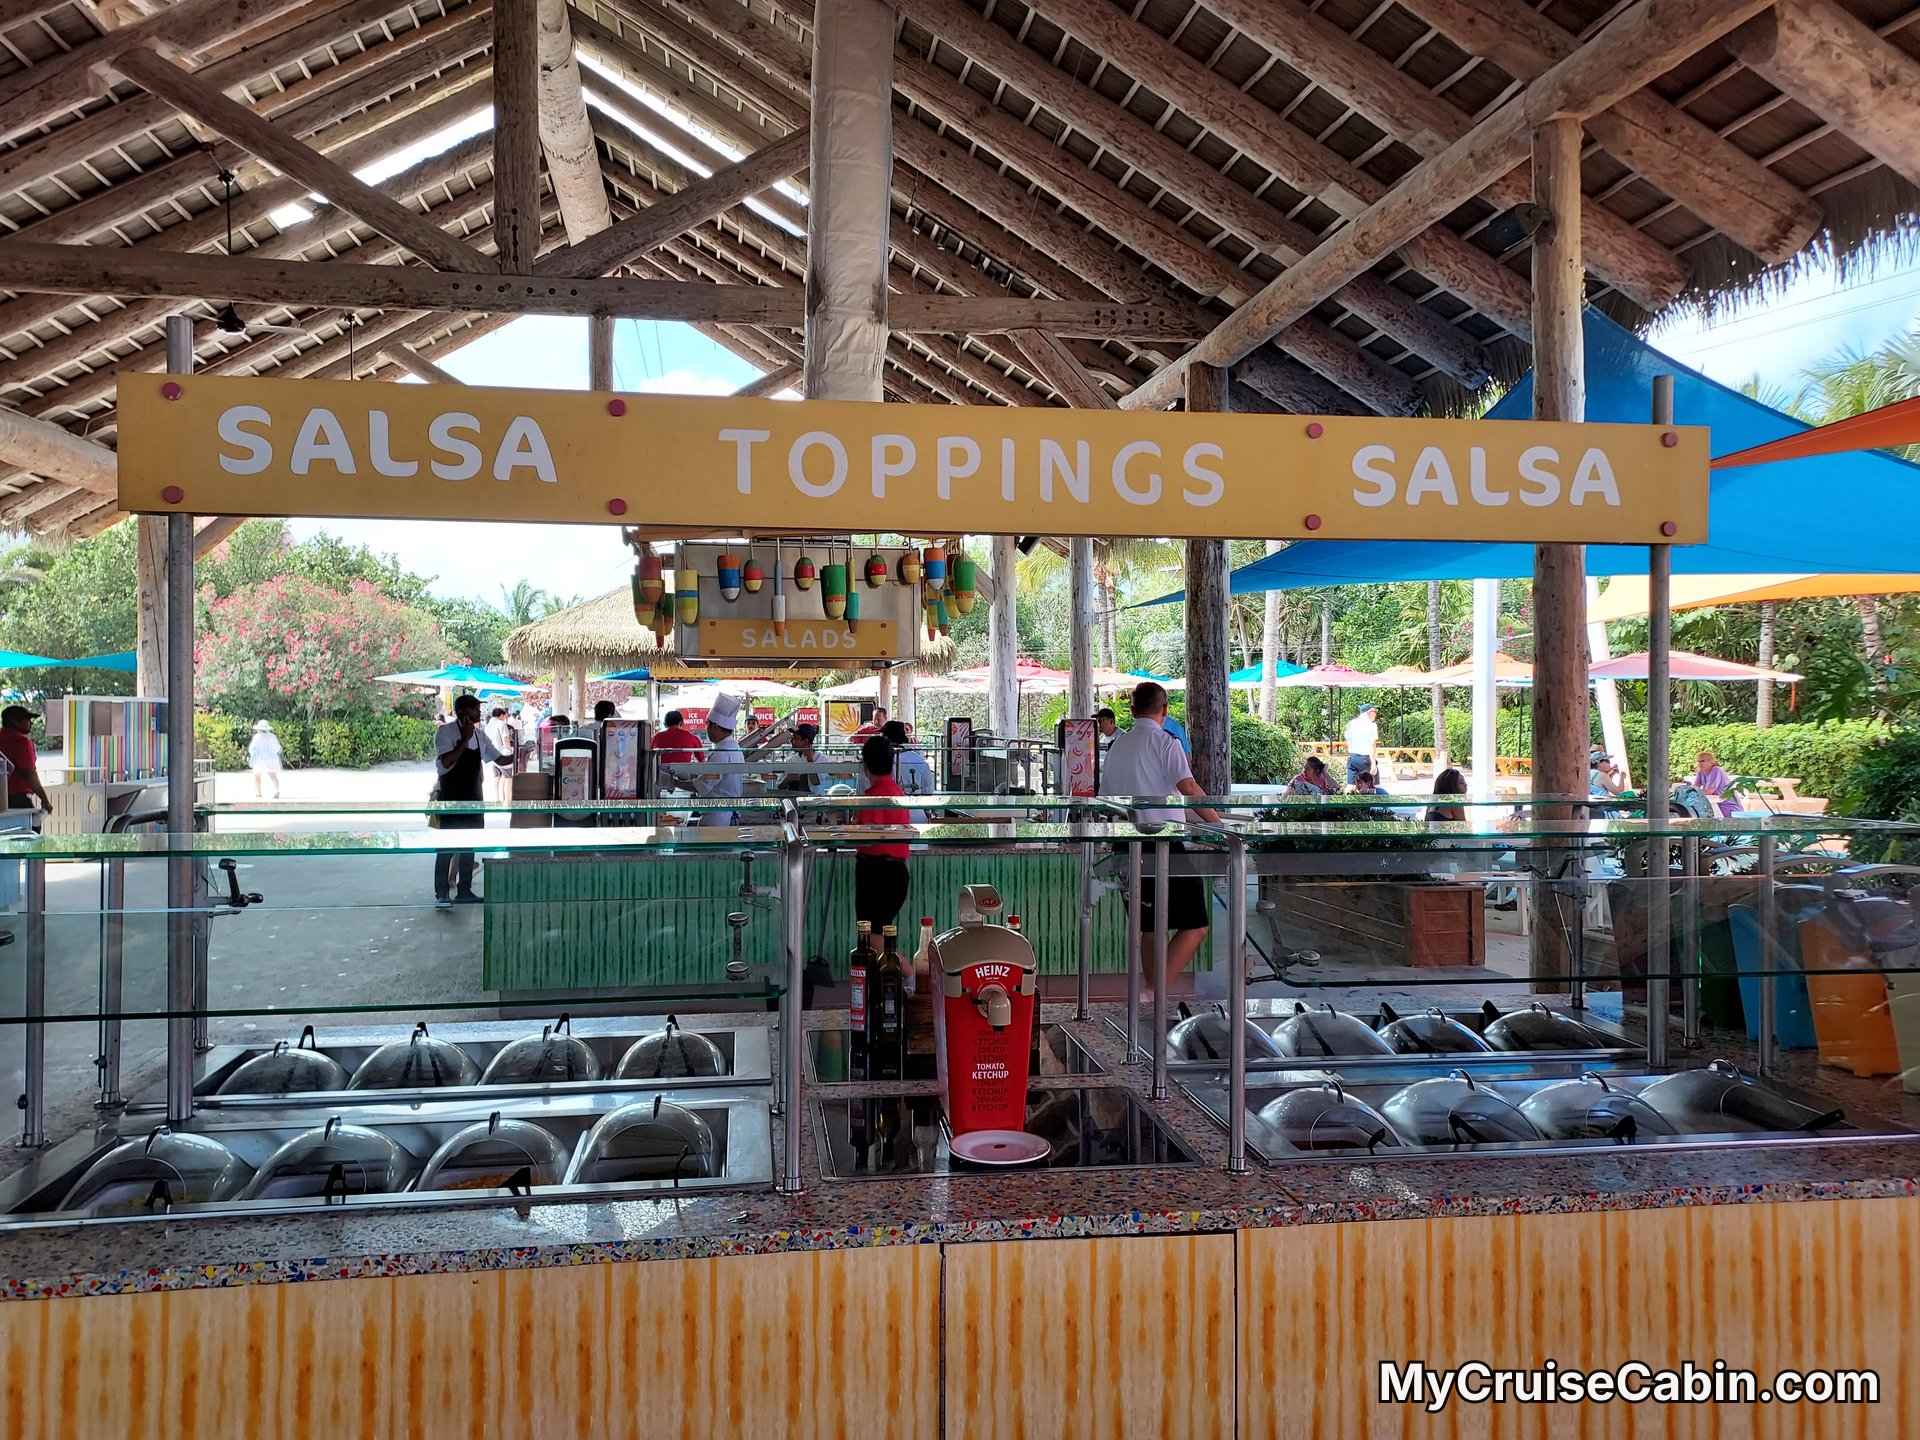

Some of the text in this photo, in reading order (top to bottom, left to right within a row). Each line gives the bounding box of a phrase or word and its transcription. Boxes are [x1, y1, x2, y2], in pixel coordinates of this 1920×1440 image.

[217, 404, 1622, 508] SALSA TOPPINGS SALSA
[742, 627, 857, 649] SALADS
[799, 713, 818, 721] JUICE
[975, 964, 1010, 979] HEINZ
[976, 1063, 1005, 1071] TOMATO
[972, 1070, 1010, 1080] KETCHUP
